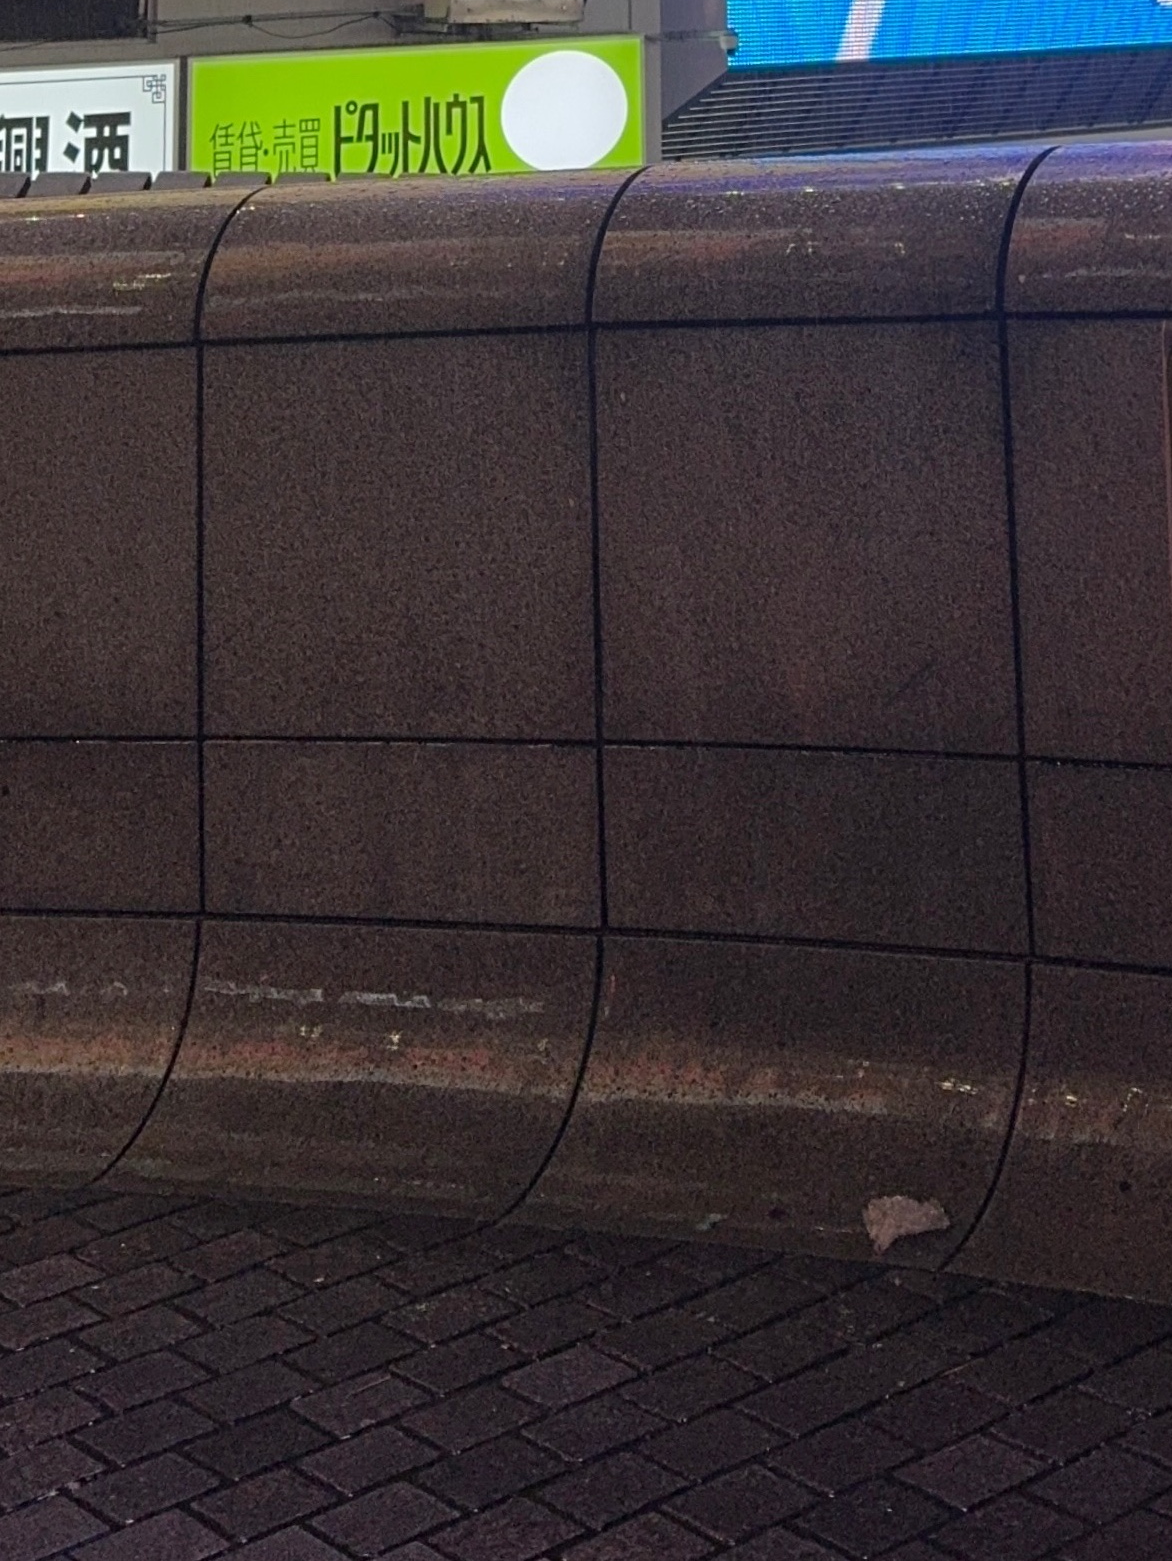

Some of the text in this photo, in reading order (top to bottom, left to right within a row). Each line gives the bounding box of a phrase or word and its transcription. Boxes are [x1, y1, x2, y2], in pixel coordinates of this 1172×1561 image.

[334, 93, 492, 177] ピタットハウス
